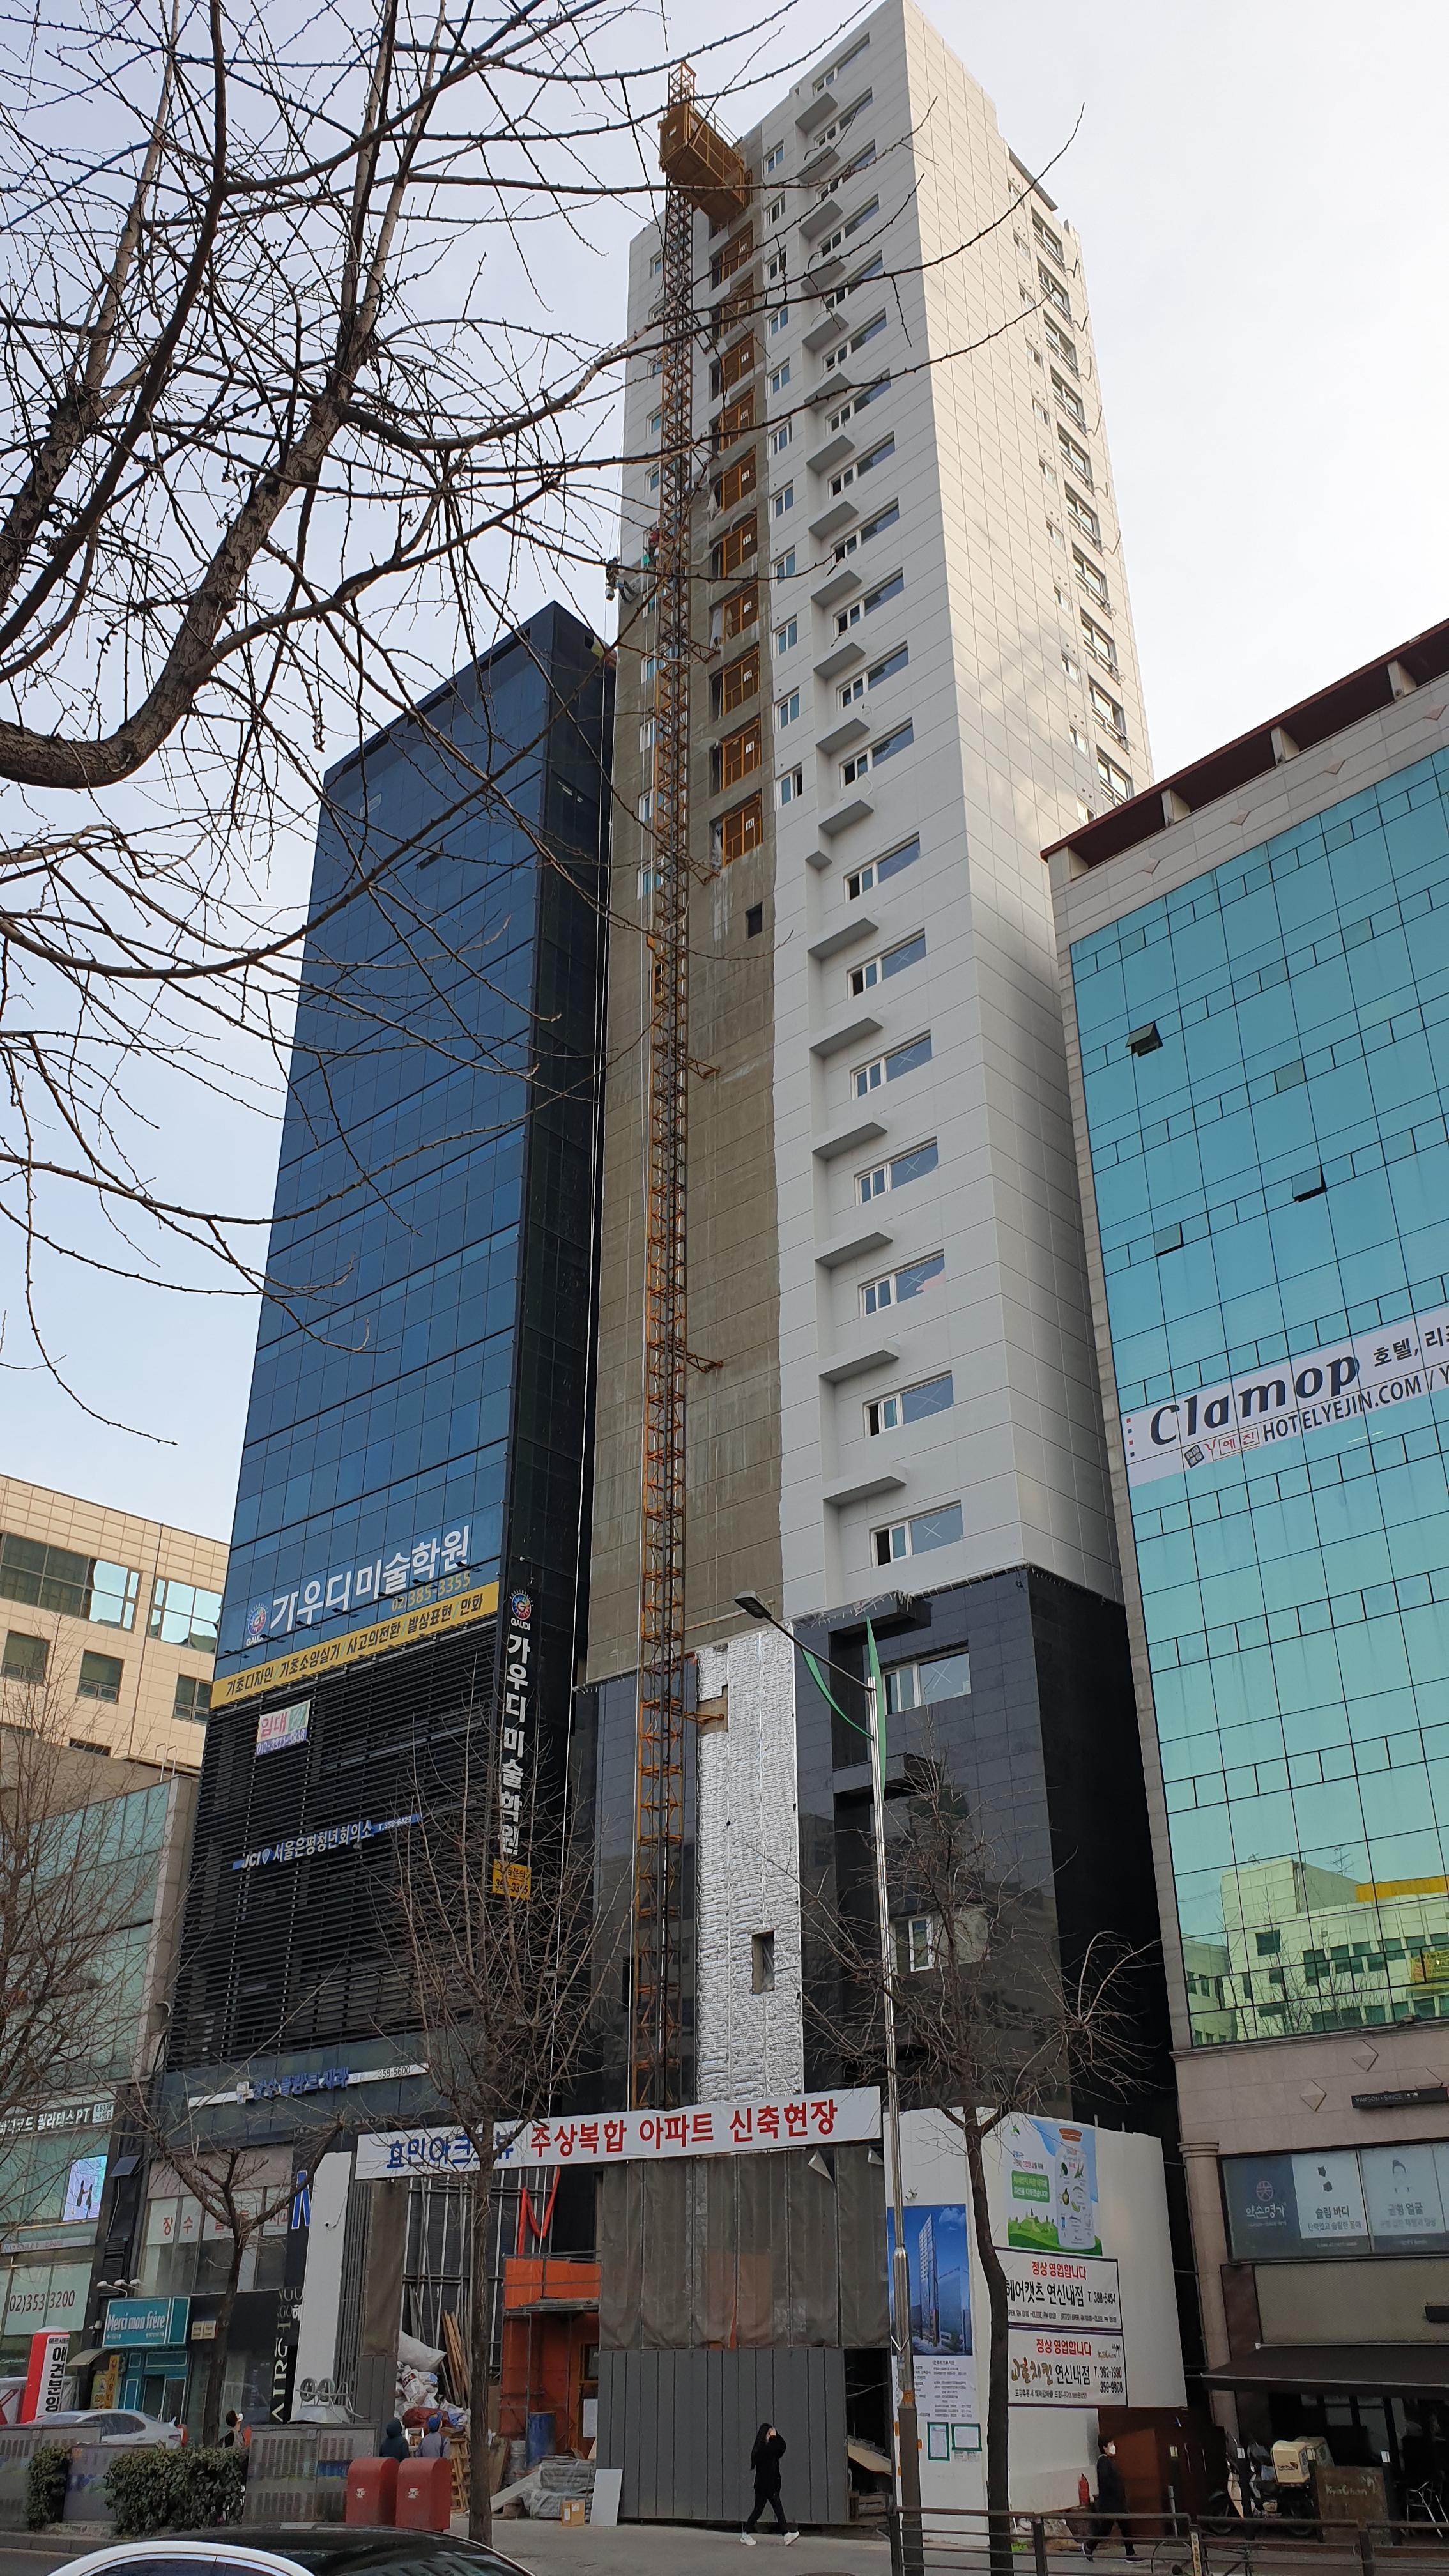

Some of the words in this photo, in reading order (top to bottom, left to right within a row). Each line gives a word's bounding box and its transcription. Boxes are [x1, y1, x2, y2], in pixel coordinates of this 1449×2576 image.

[1374, 1338, 1418, 1367] 호텔,
[1425, 1324, 1449, 1347] 리
[1150, 1356, 1360, 1446] Clamop
[1262, 1374, 1422, 1443] HOTELYEJIN.COM
[270, 1524, 470, 1632] 가우디미술학원
[510, 1617, 531, 1631] GAUDI
[226, 1666, 274, 1697] 기초디자인
[279, 1643, 341, 1678] 기초소양실기
[347, 1621, 401, 1655] 사고의전환
[408, 1603, 453, 1634] 발상표현
[460, 1593, 484, 1616] 만화
[261, 1711, 288, 1738] 임대
[497, 1633, 531, 1856] 가우디미술학원
[242, 1853, 261, 1869] JCI
[273, 1820, 374, 1862] 서울은평청년회의소
[378, 2066, 411, 2079] 358-5600
[386, 2131, 514, 2169] 효민아크뷰
[530, 2119, 627, 2158] 주상복합
[639, 2113, 714, 2149] 아파트
[728, 2099, 838, 2143] 신축현장
[1246, 2203, 1285, 2220] 약손명가
[1315, 2207, 1332, 2220] 슬림
[1333, 2205, 1350, 2218] 바디
[1032, 2261, 1048, 2276] 정상
[1048, 2263, 1087, 2280] 영업합니다
[49, 2289, 75, 2309] 3200
[1046, 2283, 1084, 2307] 연신내점
[107, 2313, 127, 2331] Merci
[128, 2314, 145, 2330] mon
[146, 2310, 166, 2330] frère
[1036, 2338, 1052, 2354] 정상
[1054, 2340, 1092, 2357] 영업합니다
[1055, 2364, 1091, 2386] 연신내점
